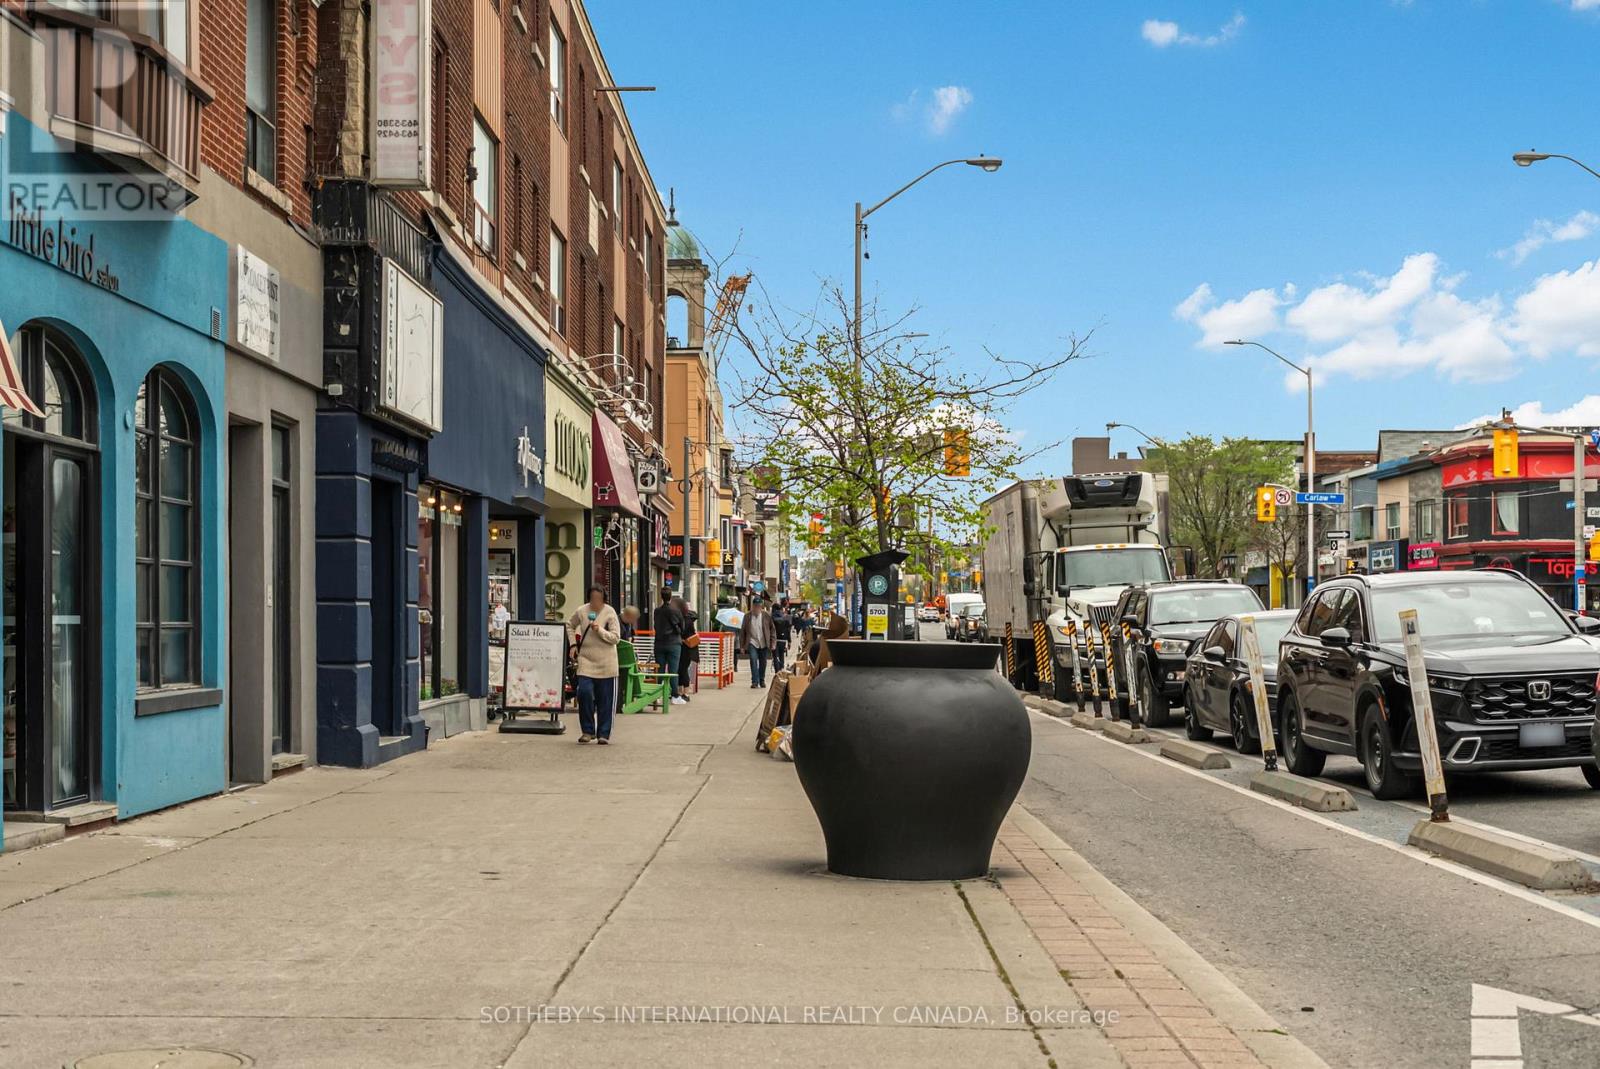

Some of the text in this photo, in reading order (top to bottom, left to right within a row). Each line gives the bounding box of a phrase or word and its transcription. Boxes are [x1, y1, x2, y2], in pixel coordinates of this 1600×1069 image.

[9, 190, 120, 292] little bird salon
[1304, 493, 1329, 502] Carlaw
[1546, 558, 1599, 578] Taps
[511, 628, 530, 637] Start
